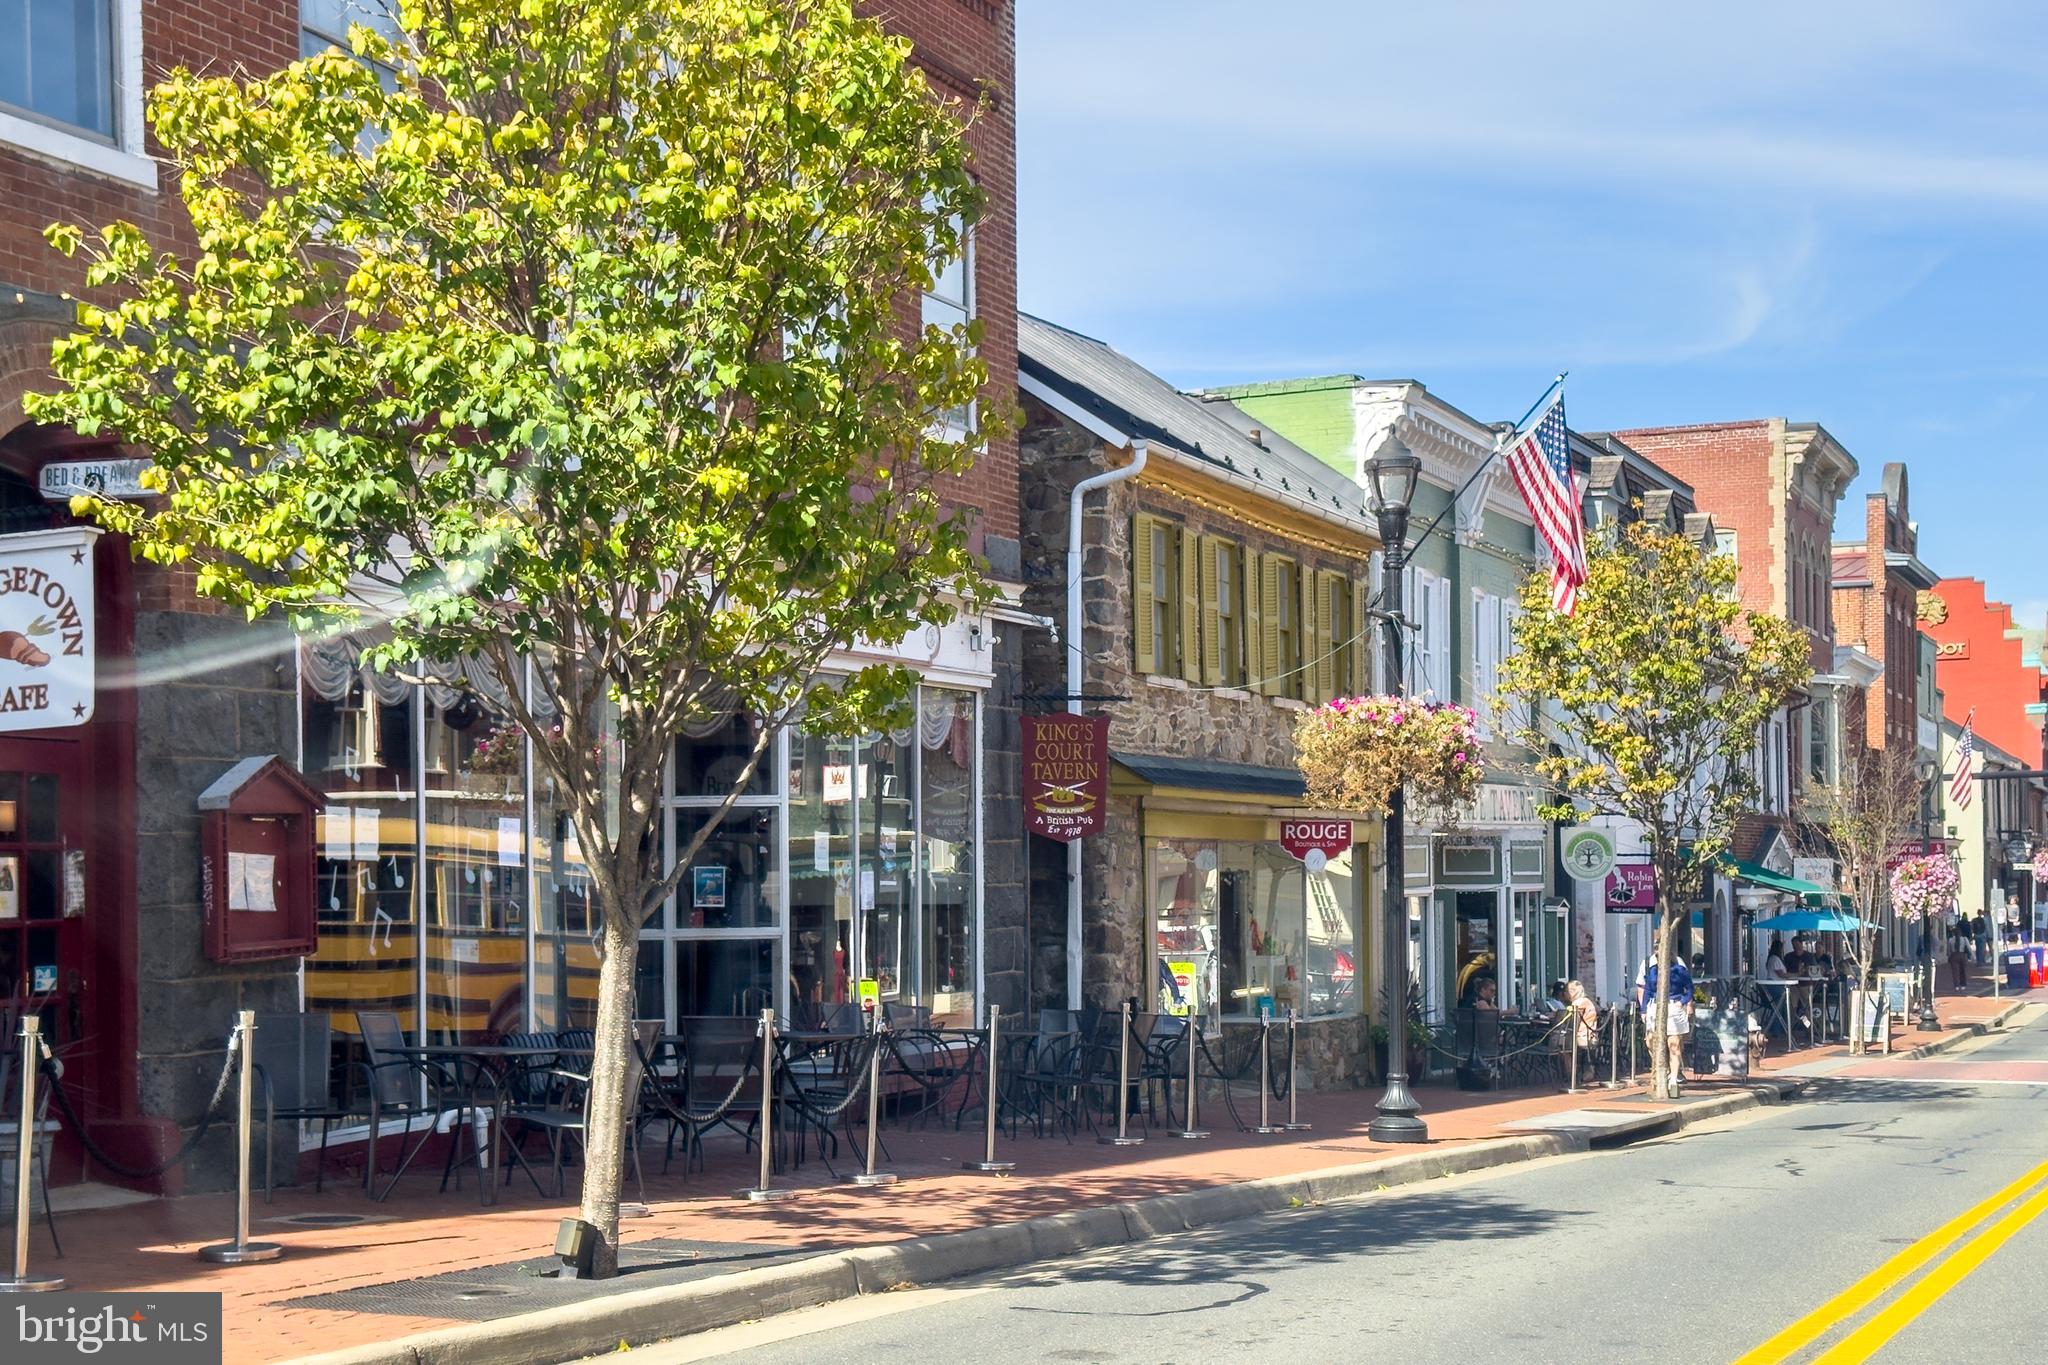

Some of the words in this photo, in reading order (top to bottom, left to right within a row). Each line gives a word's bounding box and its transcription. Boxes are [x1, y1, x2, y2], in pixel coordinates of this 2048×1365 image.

[45, 467, 68, 487] BED
[72, 466, 80, 485] &
[0, 684, 49, 713] AFE
[1035, 723, 1094, 741] KING'S
[1035, 742, 1095, 761] COURT
[1031, 762, 1098, 780] TAVERN
[1035, 816, 1044, 825] A
[1046, 815, 1074, 825] British
[1077, 815, 1094, 825] Pub
[1064, 826, 1083, 837] 1978
[1285, 824, 1347, 840] ROUGE
[1627, 870, 1654, 882] Robin
